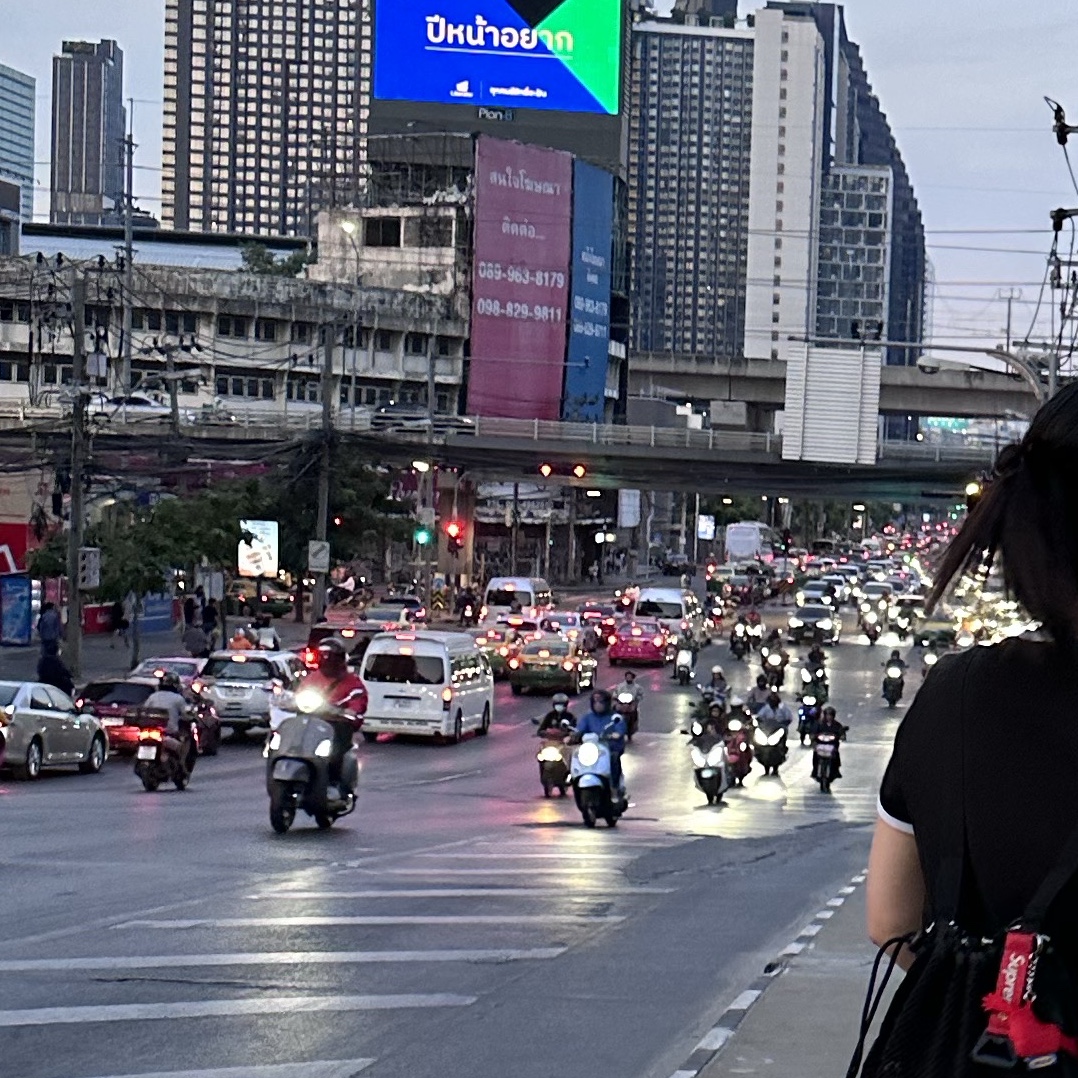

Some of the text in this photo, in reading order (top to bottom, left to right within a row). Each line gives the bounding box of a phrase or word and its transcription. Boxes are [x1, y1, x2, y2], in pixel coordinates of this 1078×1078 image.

[425, 14, 574, 52] ปีหน้าอยาก
[489, 166, 561, 196] สนใจโฆษณา
[478, 261, 565, 289] 089-963-8179
[477, 298, 562, 322] 098-829-9811
[1002, 951, 1026, 1004] Supre
